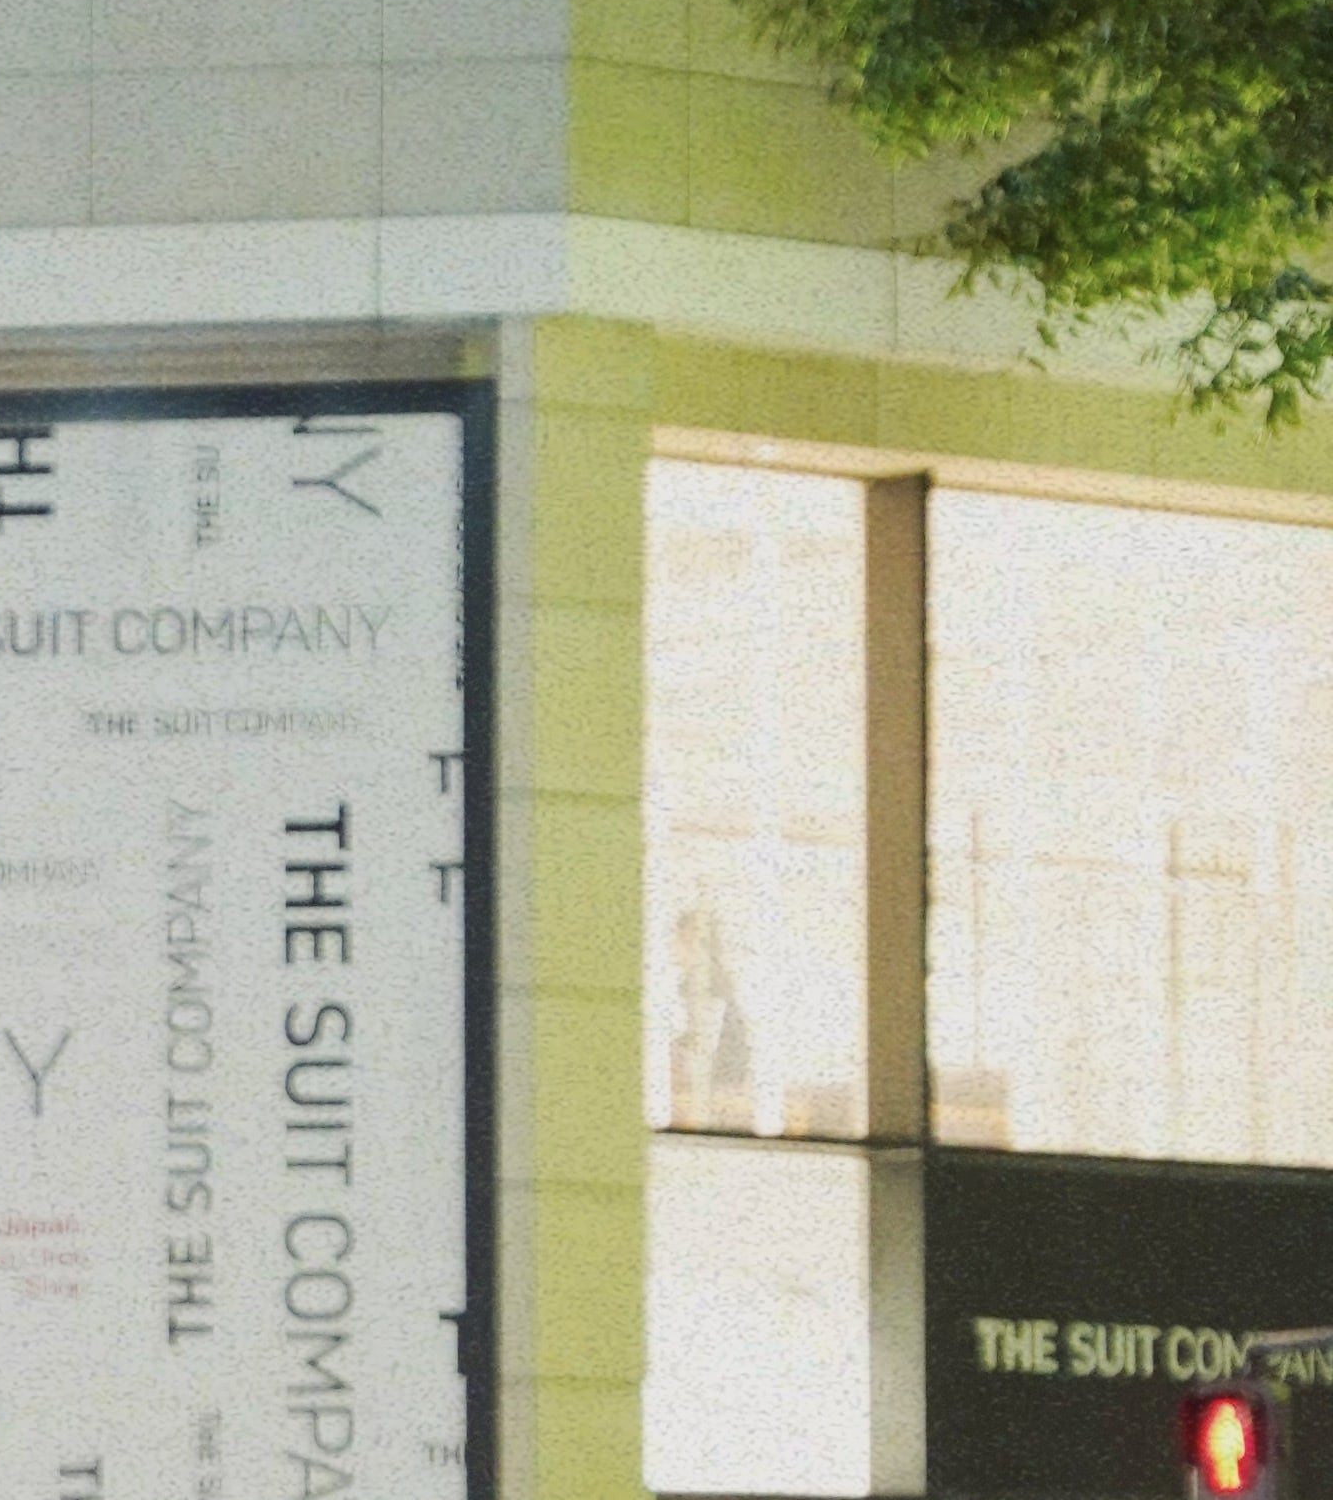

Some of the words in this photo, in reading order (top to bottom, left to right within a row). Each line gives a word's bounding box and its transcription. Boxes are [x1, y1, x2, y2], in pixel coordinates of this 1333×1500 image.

[112, 603, 392, 657] COMPANY
[89, 711, 138, 735] THE
[166, 798, 214, 1073] COMPANY
[285, 802, 352, 964] THE
[167, 1087, 214, 1211] SUIT
[285, 1002, 353, 1188] SUIT
[167, 1235, 214, 1345] THE
[974, 1317, 1060, 1375] THE
[1065, 1321, 1161, 1378] SUIT
